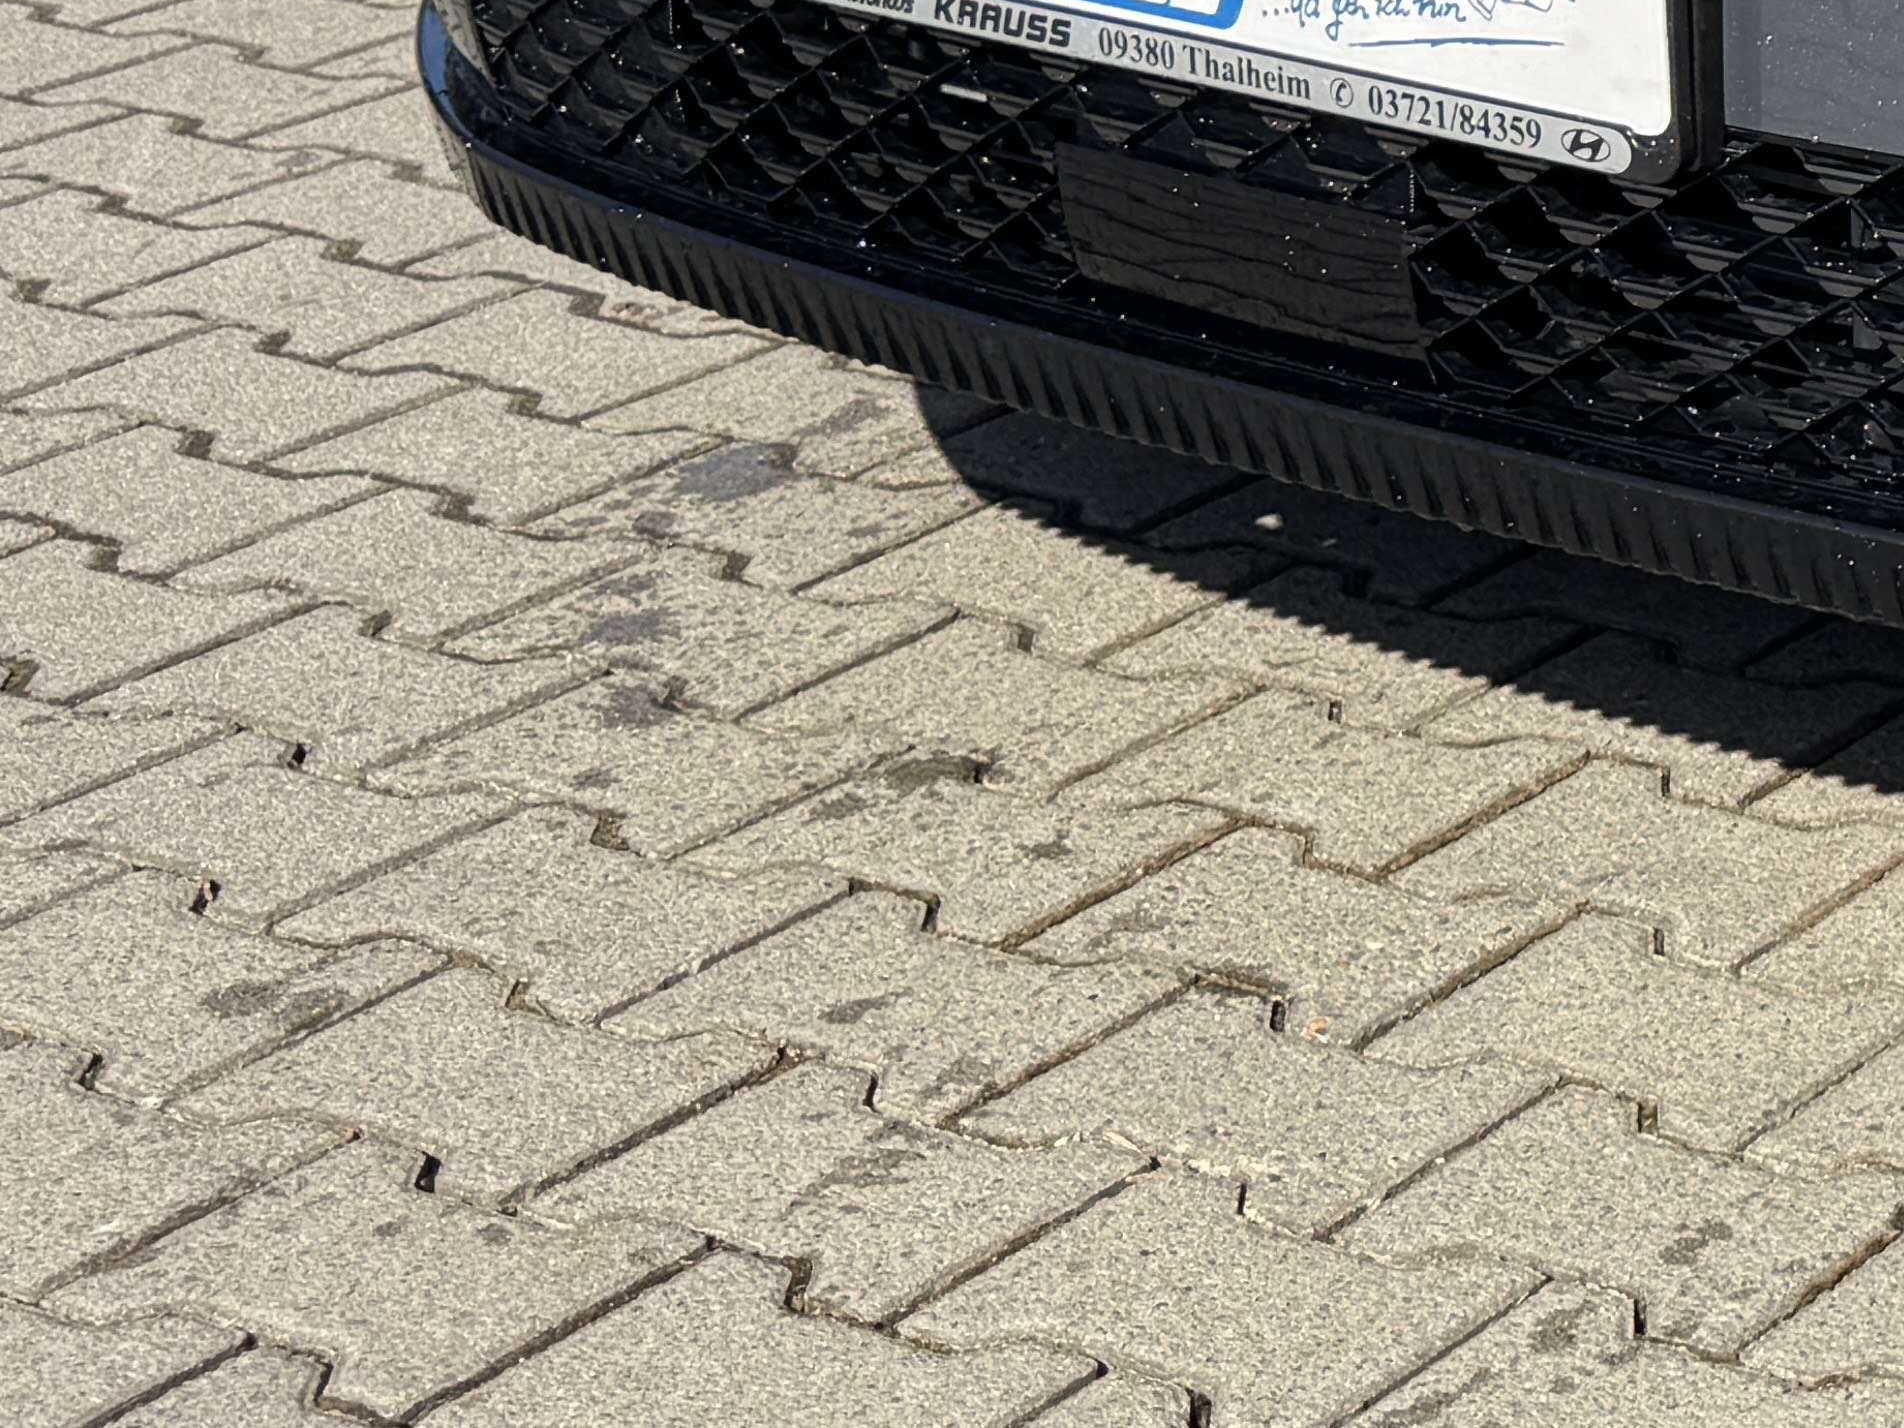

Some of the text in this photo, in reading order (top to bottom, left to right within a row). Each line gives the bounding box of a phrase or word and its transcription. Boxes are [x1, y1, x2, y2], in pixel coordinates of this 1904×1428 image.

[1099, 27, 1175, 70] 09380
[1183, 45, 1311, 100] Thalheim
[1368, 87, 1542, 148] 03721/84359
